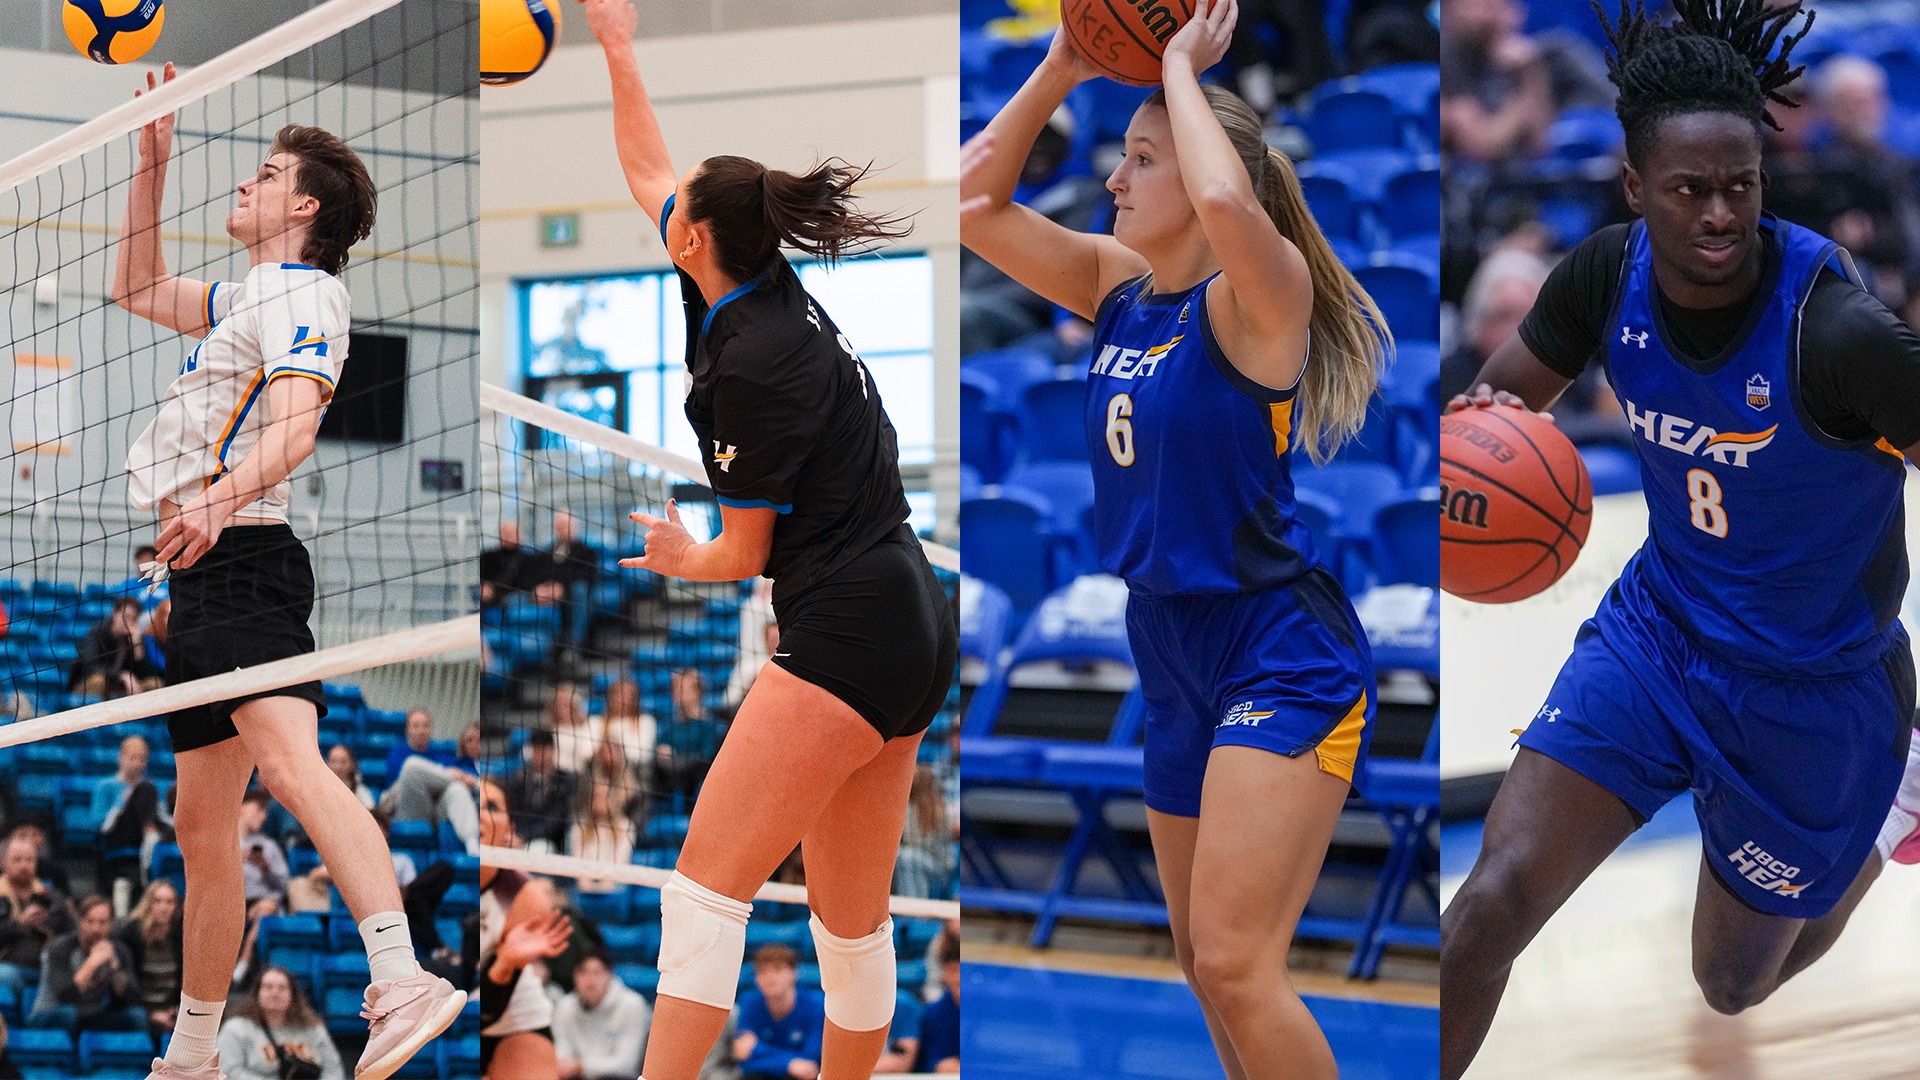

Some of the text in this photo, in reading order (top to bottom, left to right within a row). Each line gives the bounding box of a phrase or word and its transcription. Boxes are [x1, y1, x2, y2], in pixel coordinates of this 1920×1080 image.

[1105, 392, 1136, 468] 6
[1749, 395, 1768, 405] WEST
[1625, 398, 1780, 469] HEAT
[1686, 467, 1729, 539] 8
[1727, 847, 1815, 899] HEAT
[1742, 840, 1801, 879] UBCO
